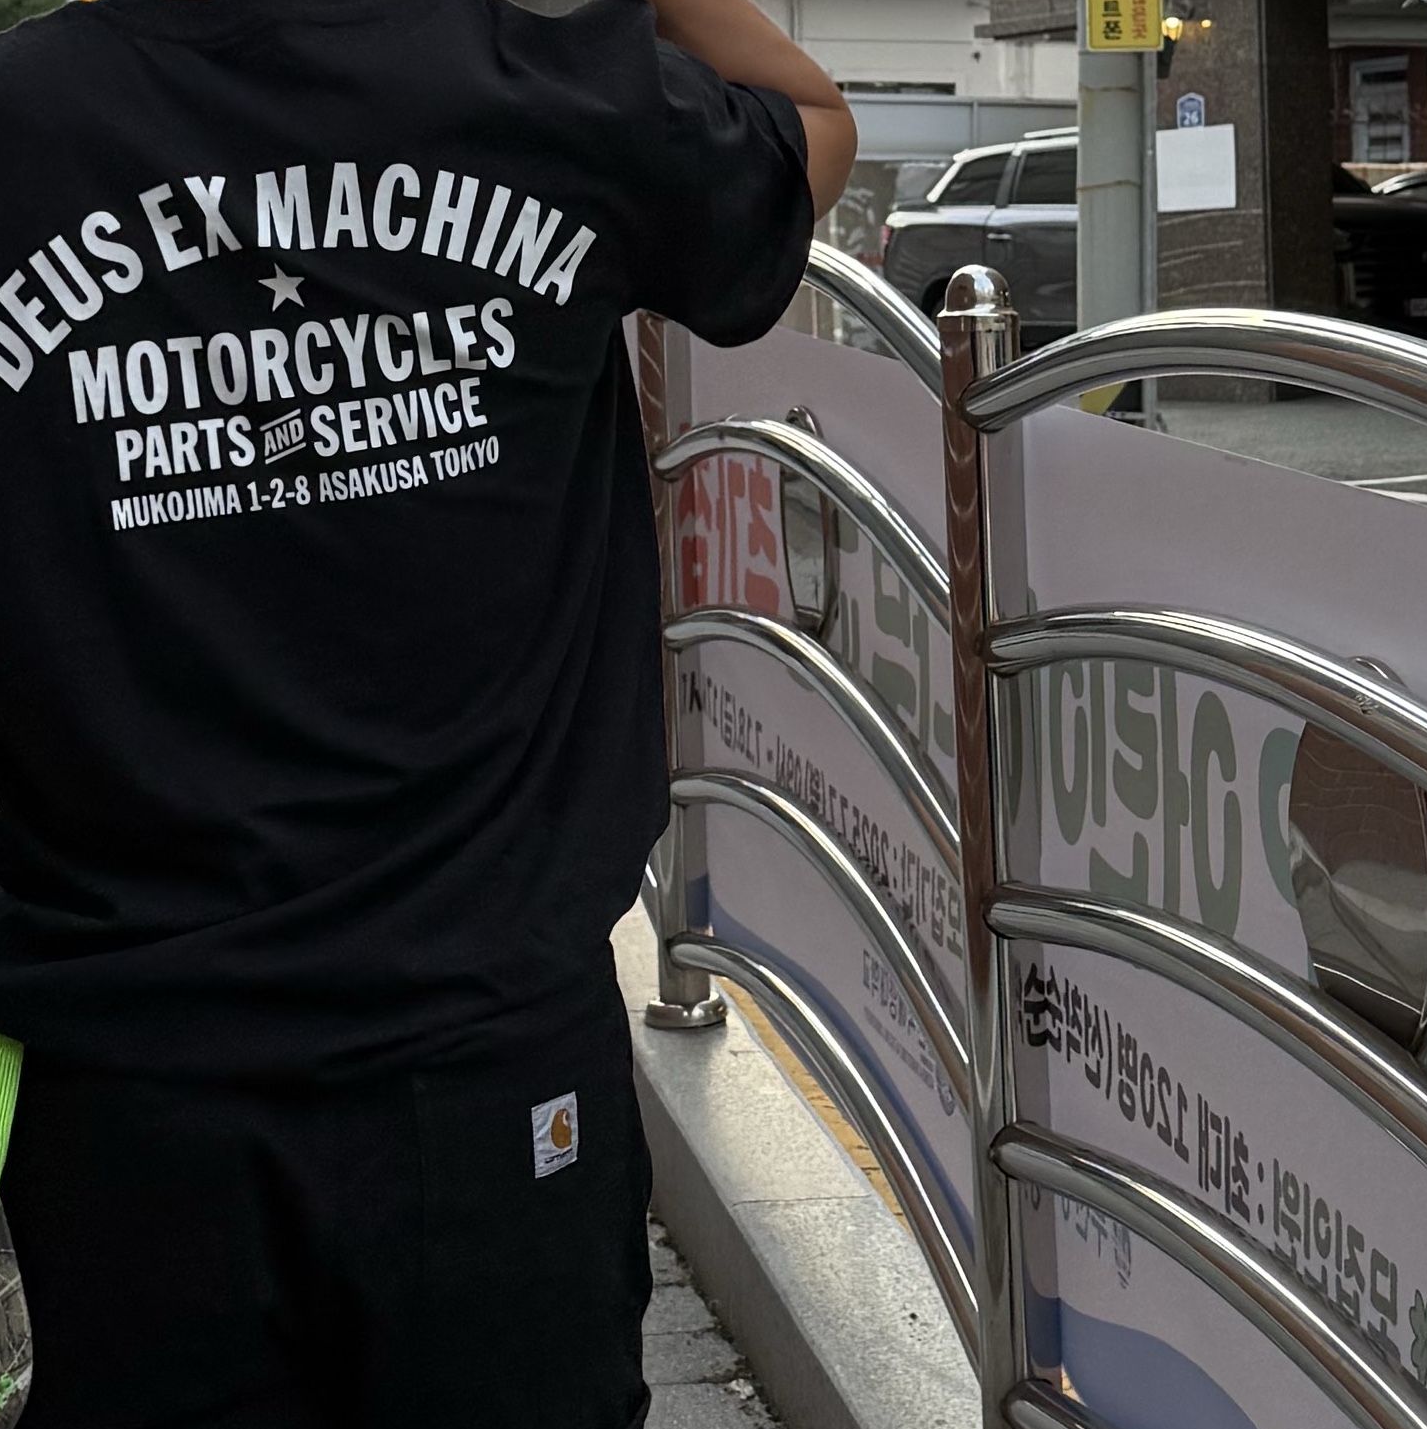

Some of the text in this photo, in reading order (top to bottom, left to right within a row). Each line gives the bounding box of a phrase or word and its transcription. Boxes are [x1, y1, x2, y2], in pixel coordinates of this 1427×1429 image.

[138, 174, 243, 272] EX
[255, 161, 597, 306] MACHINA
[67, 297, 516, 423] MOTORCYCLES
[111, 435, 500, 531] MUKOJIMA 1-2-8 ASAKUSA TOKYO
[115, 376, 488, 482] PARTS AND SERVICE
